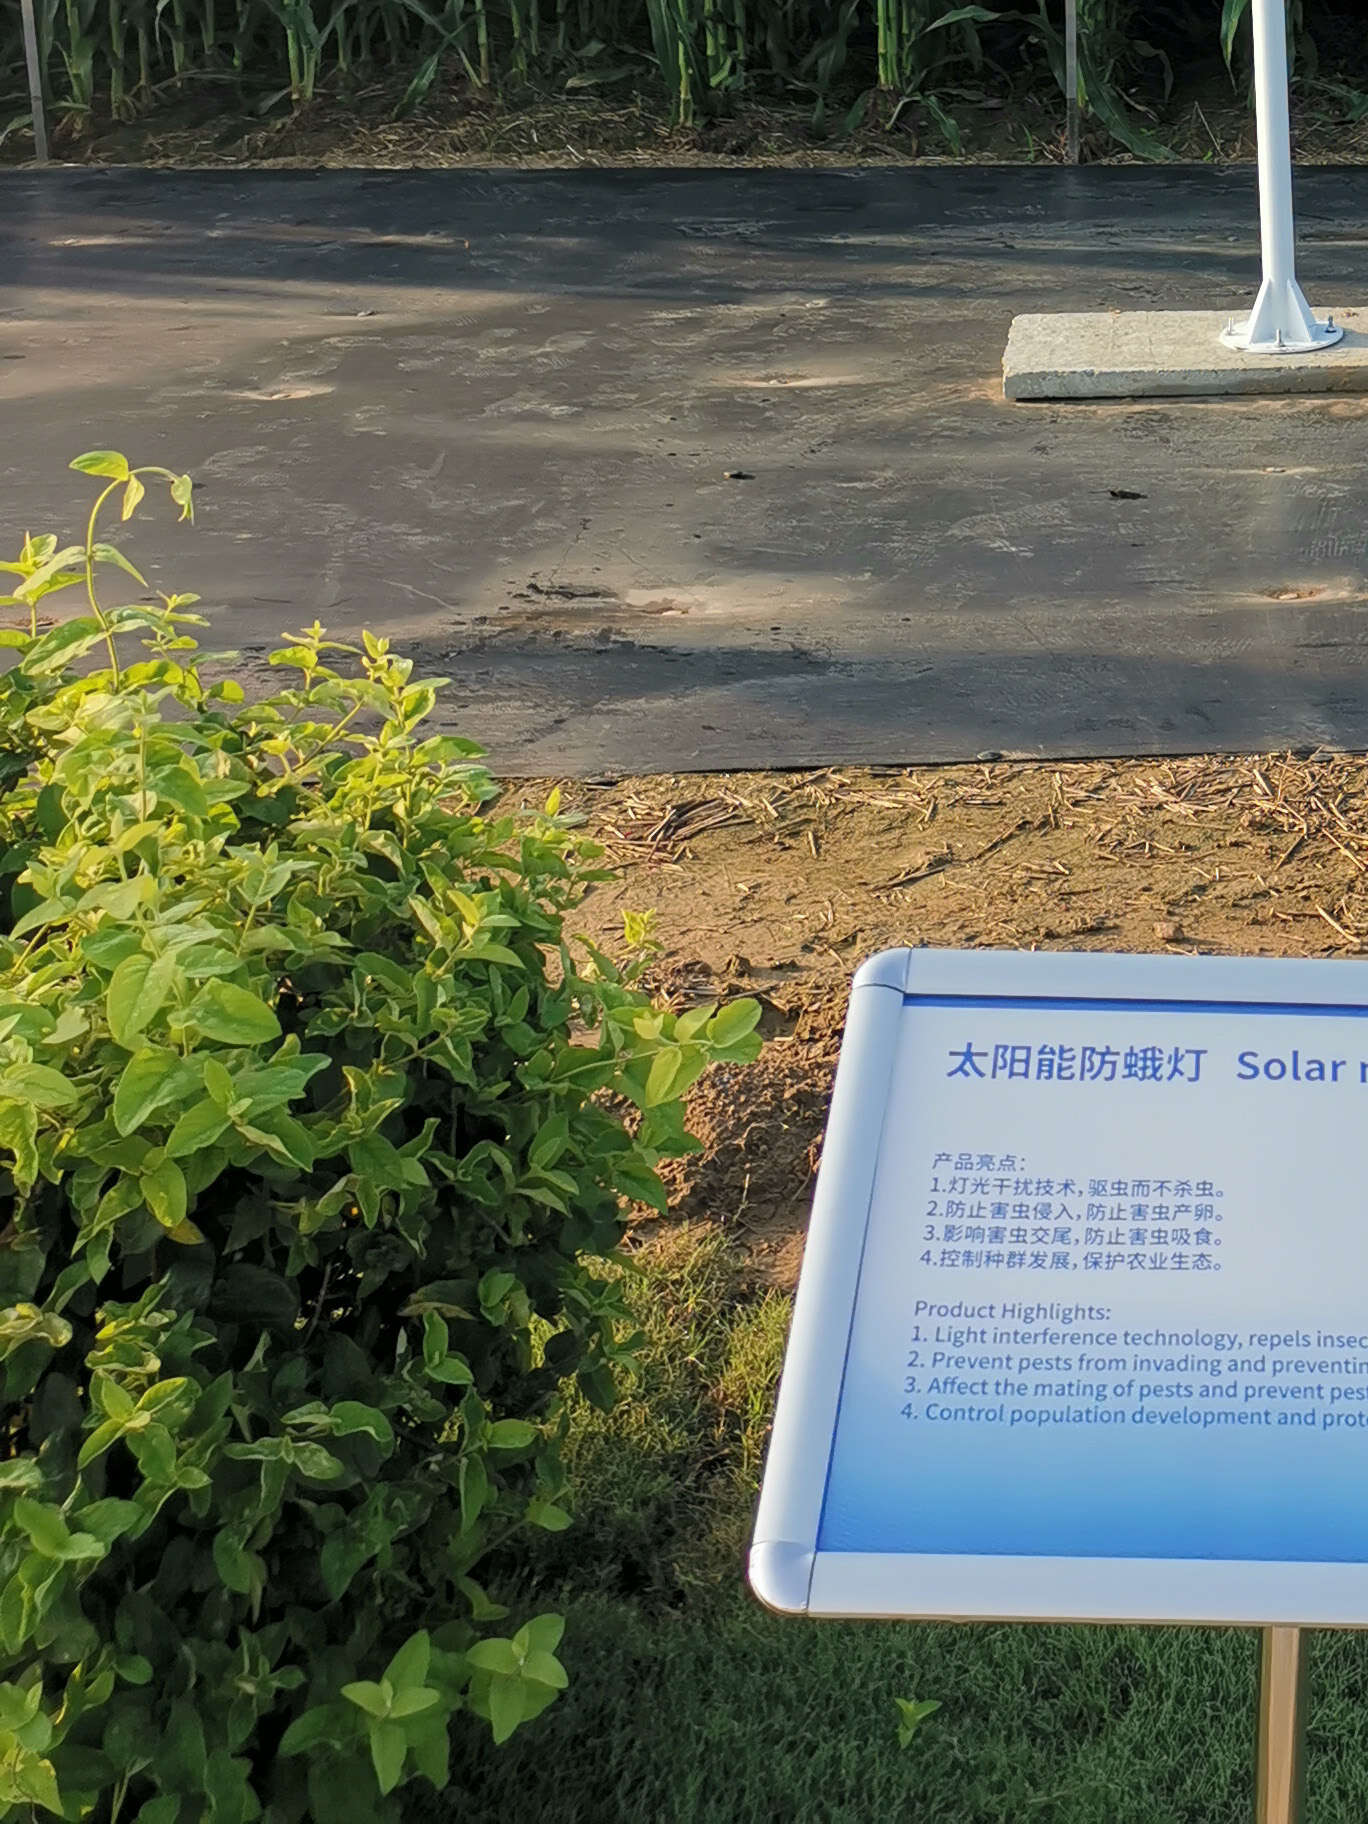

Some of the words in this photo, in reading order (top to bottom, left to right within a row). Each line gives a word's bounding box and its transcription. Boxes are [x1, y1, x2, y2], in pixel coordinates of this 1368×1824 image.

[945, 1041, 1209, 1083] 太阳能防蛾灯
[1236, 1049, 1348, 1083] Solar
[914, 1300, 997, 1319] Product
[1001, 1302, 1112, 1326] Highlights:
[911, 1325, 928, 1343] 1.
[934, 1325, 988, 1349] Light
[992, 1326, 1118, 1346] interference
[1123, 1328, 1243, 1352] technology,
[1248, 1329, 1312, 1352] repels
[906, 1350, 925, 1368] 2.
[931, 1351, 1014, 1371] Prevent
[1017, 1355, 1073, 1375] pests
[1078, 1352, 1127, 1372] from
[1133, 1353, 1222, 1378] invading
[1227, 1354, 1266, 1373] and
[904, 1375, 921, 1394] 3.
[927, 1375, 989, 1396] Affect
[994, 1377, 1029, 1397] the
[1033, 1379, 1108, 1403] mating
[1112, 1378, 1135, 1398] of
[1138, 1382, 1194, 1403] pests
[1198, 1380, 1238, 1399] and
[1244, 1383, 1325, 1403] prevent
[900, 1402, 918, 1420] 4.
[925, 1402, 1004, 1422] Control
[1010, 1405, 1126, 1427] population
[1131, 1405, 1272, 1429] development
[1277, 1407, 1316, 1426] and
